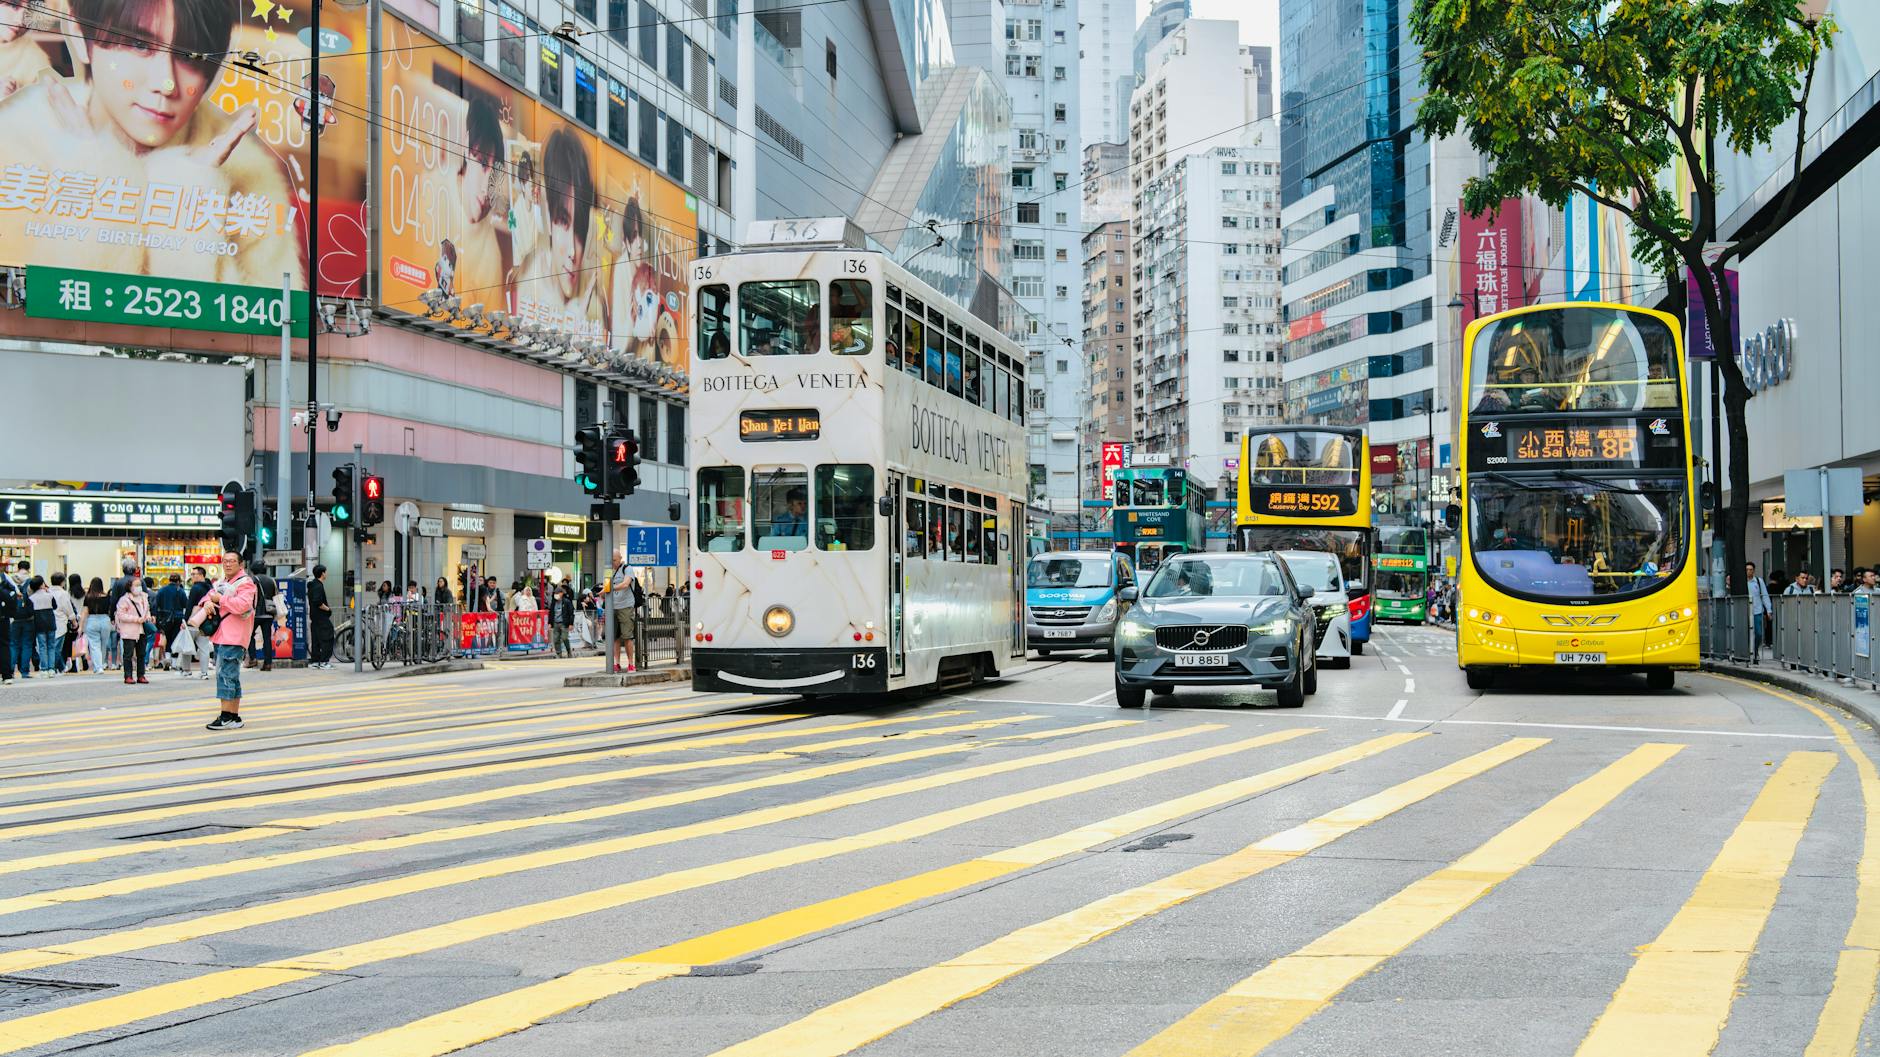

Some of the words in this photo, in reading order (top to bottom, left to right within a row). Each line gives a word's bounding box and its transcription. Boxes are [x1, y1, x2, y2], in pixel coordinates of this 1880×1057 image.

[390, 84, 450, 176] 0430
[390, 164, 450, 249] 0430
[25, 221, 88, 242] HAPPY
[96, 228, 185, 252] BIRTHDAY
[195, 239, 239, 257] 0430
[769, 221, 820, 242] 136
[1500, 228, 1508, 266] LUKFOOK
[694, 266, 713, 281] 136
[843, 259, 868, 274] 136
[1475, 228, 1499, 315] 六福珠寶
[123, 285, 202, 320] 2523
[213, 293, 285, 328] 1840
[703, 374, 779, 393] BOTTEGA
[797, 373, 868, 390] VENETA
[741, 419, 769, 434] Shau
[773, 418, 793, 433] Kei
[797, 417, 820, 433] Wan
[911, 403, 968, 466] BOTTEGA
[976, 429, 1013, 480] VENETA
[1521, 430, 1590, 448] 小西灣
[1518, 447, 1539, 458] Siu
[1542, 447, 1563, 458] Sai
[1565, 447, 1593, 458] Wan
[1602, 438, 1634, 459] 8P
[1143, 455, 1160, 463] 141
[102, 503, 134, 513] TONG
[138, 504, 161, 514] YAN
[1268, 503, 1297, 511] Causeway
[1298, 503, 1311, 511] Bay
[1311, 494, 1340, 511] 592
[852, 653, 876, 669] 136
[1180, 655, 1194, 665] YU
[1198, 655, 1224, 665] 8851
[1560, 653, 1574, 662] UH
[1578, 653, 1601, 662] 7961
